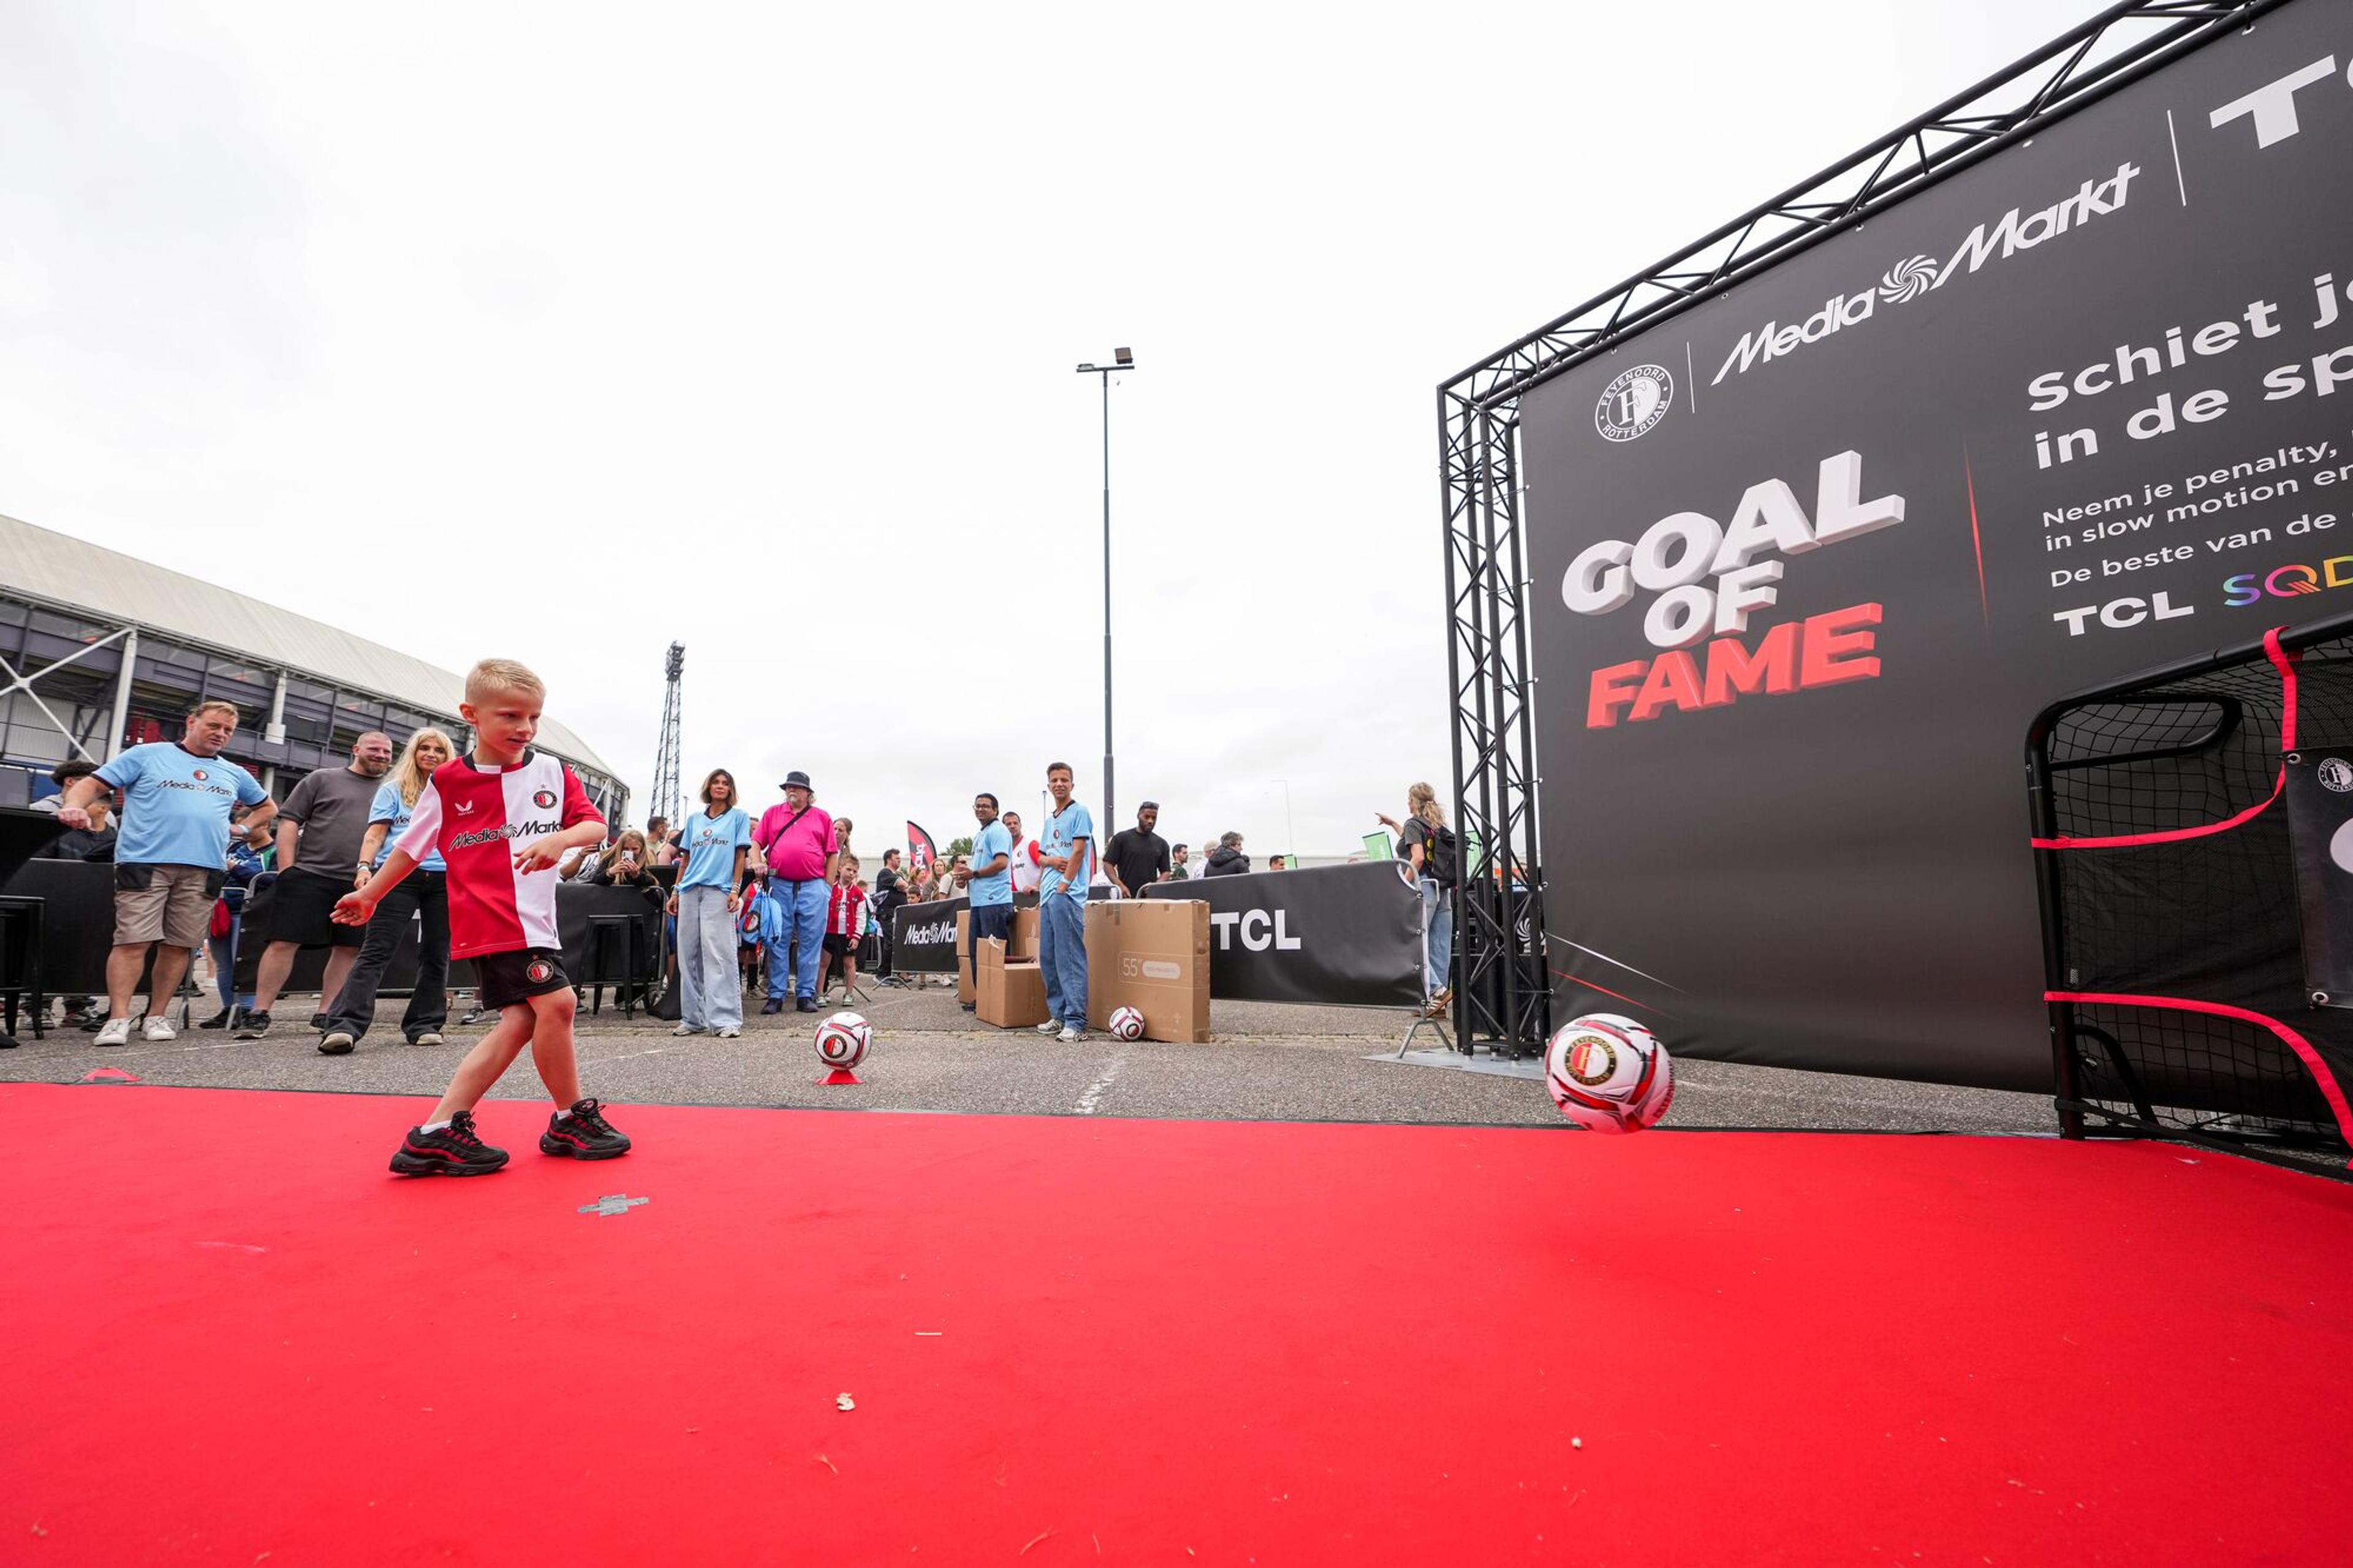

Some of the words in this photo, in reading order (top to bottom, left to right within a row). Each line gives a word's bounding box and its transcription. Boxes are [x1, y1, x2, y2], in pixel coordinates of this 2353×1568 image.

[2210, 55, 2353, 149] T
[1711, 287, 1876, 385] Media
[1930, 162, 2140, 291] Markt
[2028, 300, 2281, 411] Schiet
[2314, 273, 2353, 329] j
[1601, 368, 1665, 406] FEYENOORD
[1602, 400, 1667, 439] ROTTERDAM
[2035, 428, 2098, 469] in
[2126, 390, 2229, 439] de
[2043, 494, 2132, 527] Neem
[2143, 484, 2173, 505] je
[2186, 441, 2337, 494] penalty,
[2046, 535, 2072, 551] in
[2082, 513, 2154, 543] slow
[2167, 480, 2299, 522] motion
[1561, 449, 1906, 616] GOAL
[2051, 568, 2092, 588] De
[2102, 545, 2194, 576] beste
[2205, 526, 2272, 553] van
[2286, 513, 2337, 536] de
[1643, 560, 1784, 648] OF
[2053, 591, 2194, 637] TCL
[1586, 602, 1883, 729] FAME
[449, 828, 500, 852] Media
[1210, 909, 1302, 952] TCL
